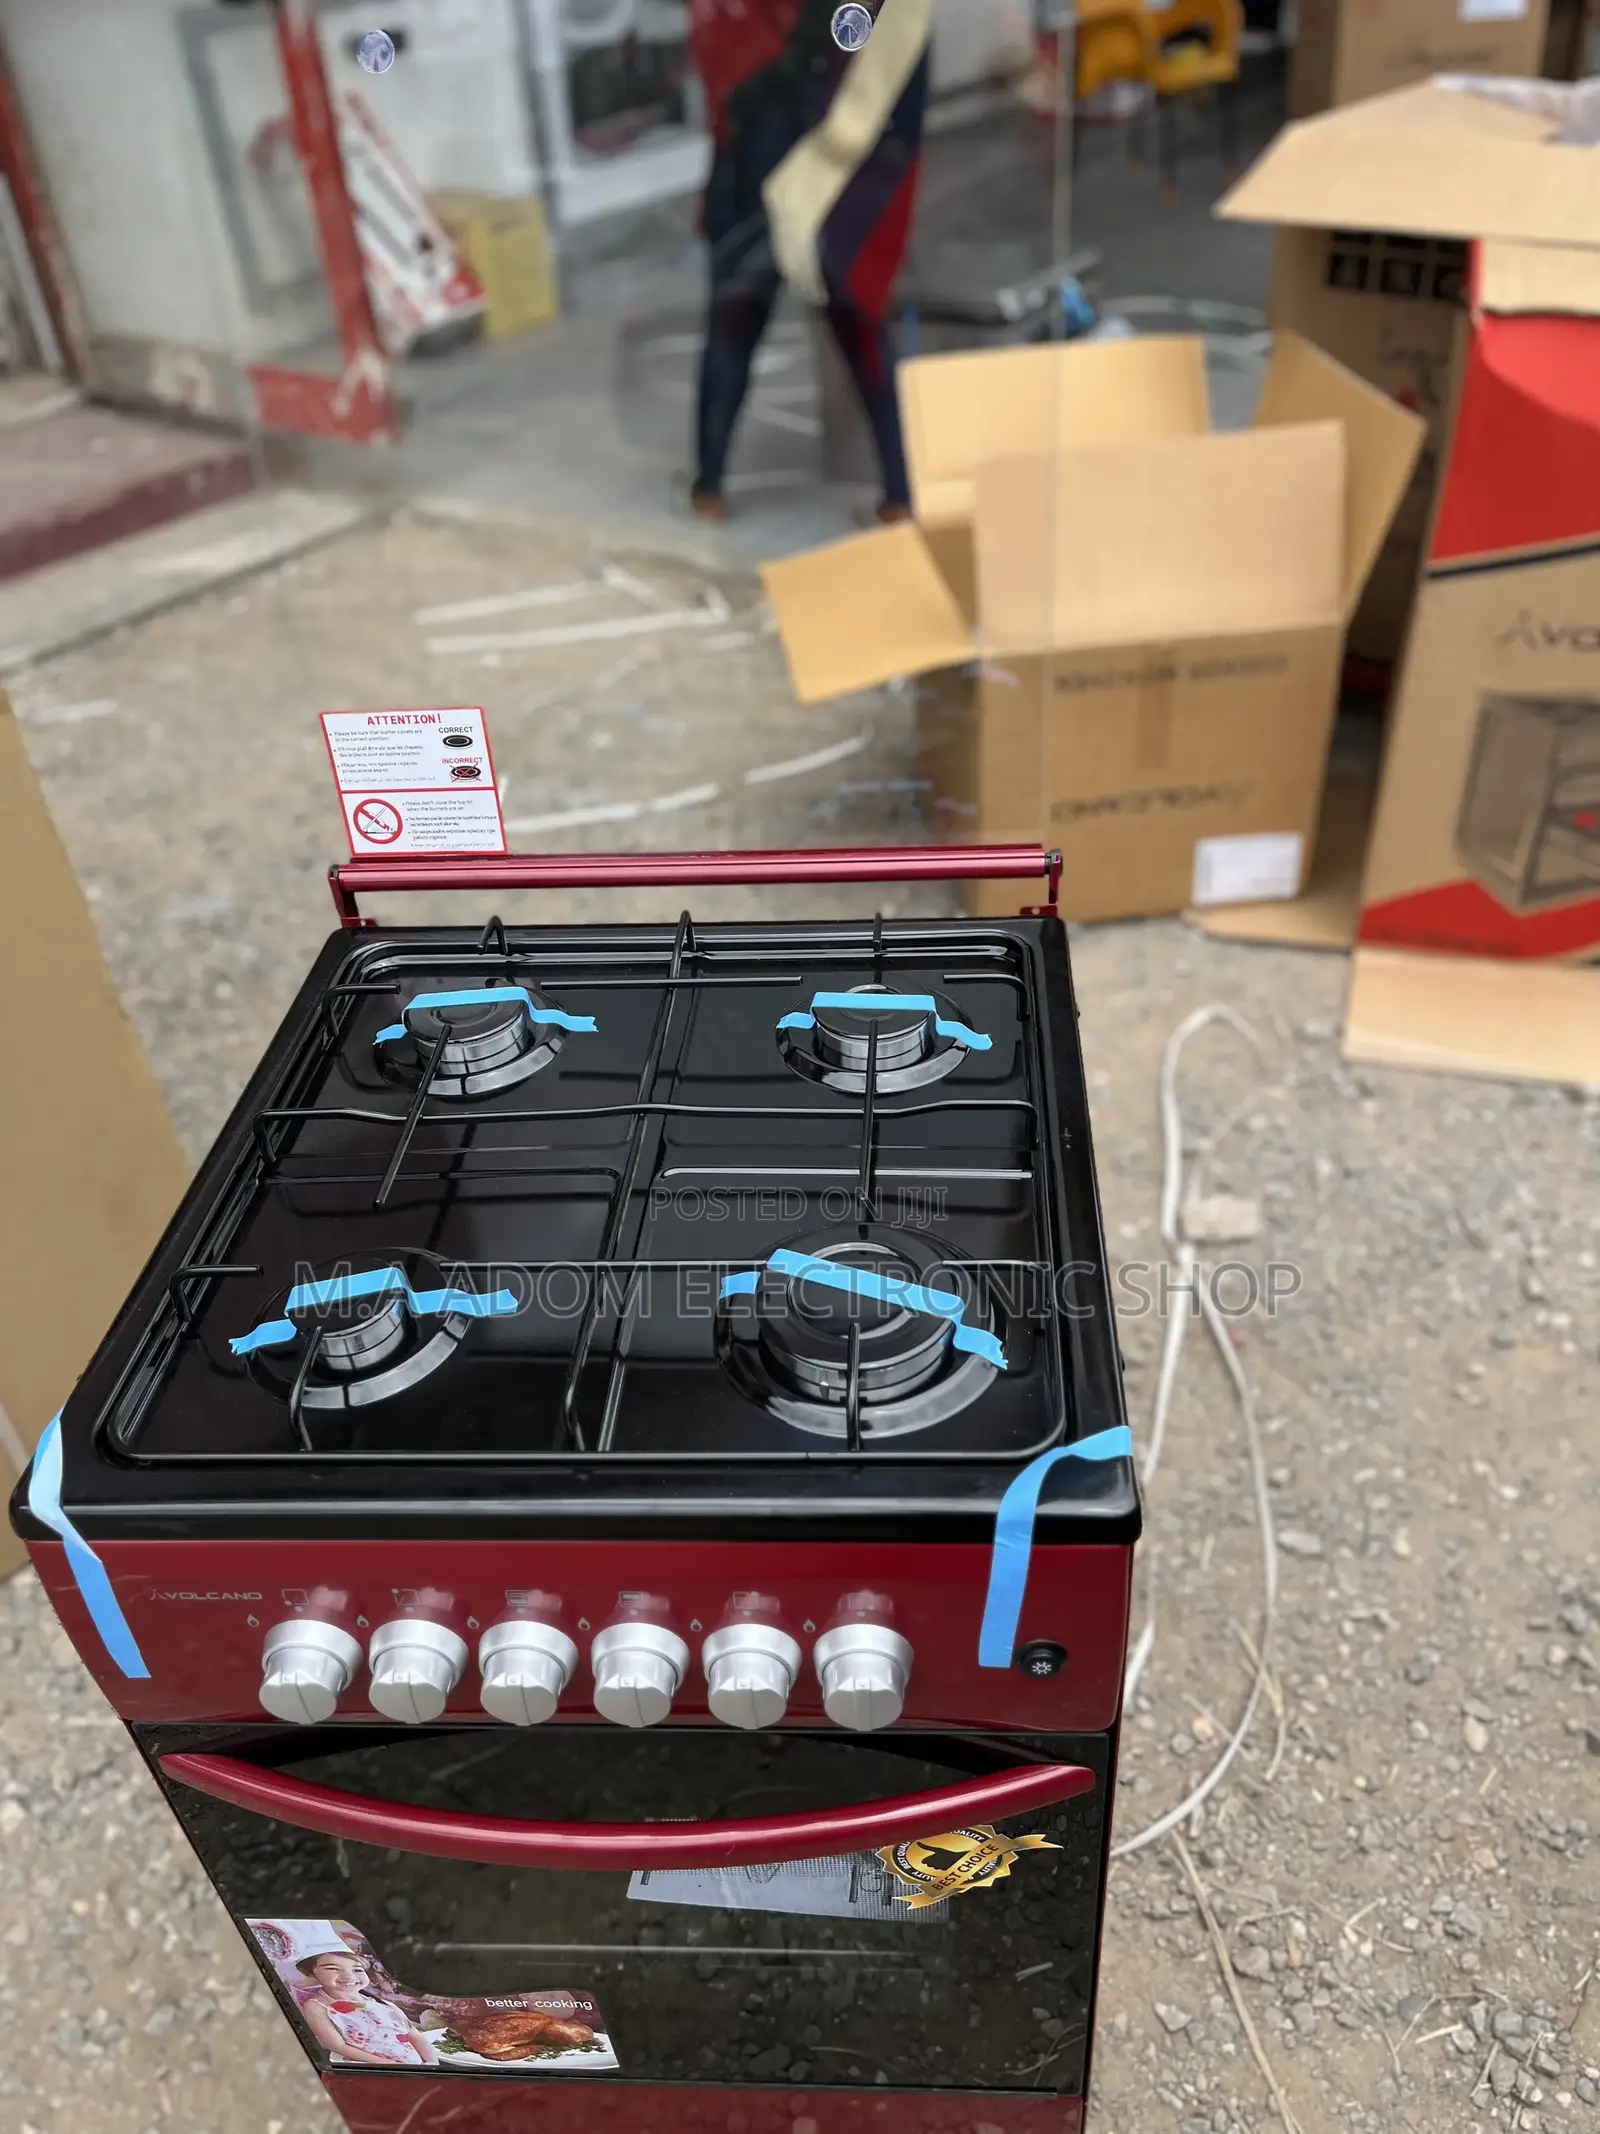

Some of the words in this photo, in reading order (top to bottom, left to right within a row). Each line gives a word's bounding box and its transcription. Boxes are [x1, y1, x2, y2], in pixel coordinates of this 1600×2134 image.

[367, 713, 442, 726] ATTENTION!
[438, 726, 473, 734] CORRECT
[164, 1591, 263, 1600] VOLCANO
[932, 1871, 961, 1891] BEST
[957, 1843, 999, 1873] CHOICE
[484, 1998, 528, 2008] better
[534, 1999, 593, 2011] cooking
